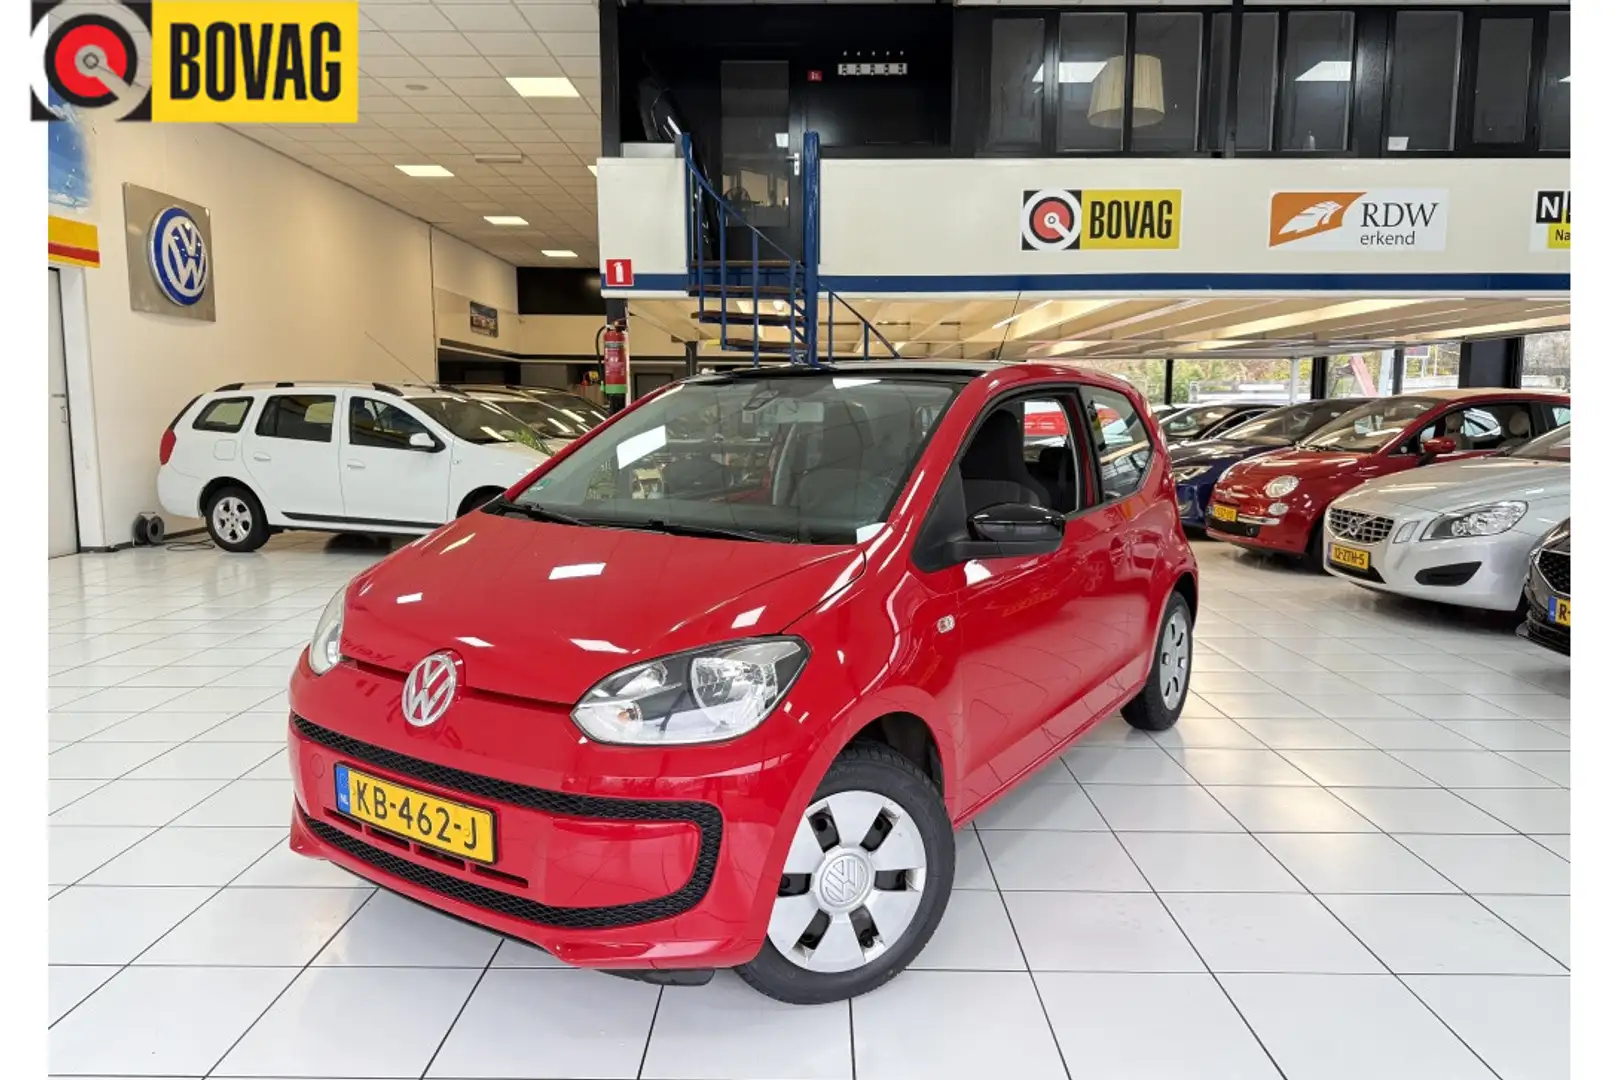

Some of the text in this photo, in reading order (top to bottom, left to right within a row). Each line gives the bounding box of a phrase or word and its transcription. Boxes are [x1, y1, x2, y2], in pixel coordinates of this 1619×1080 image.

[1089, 200, 1173, 239] BOVAG
[1360, 202, 1440, 227] RDW
[1360, 230, 1415, 246] erkend
[356, 779, 477, 849] KB-462-J
